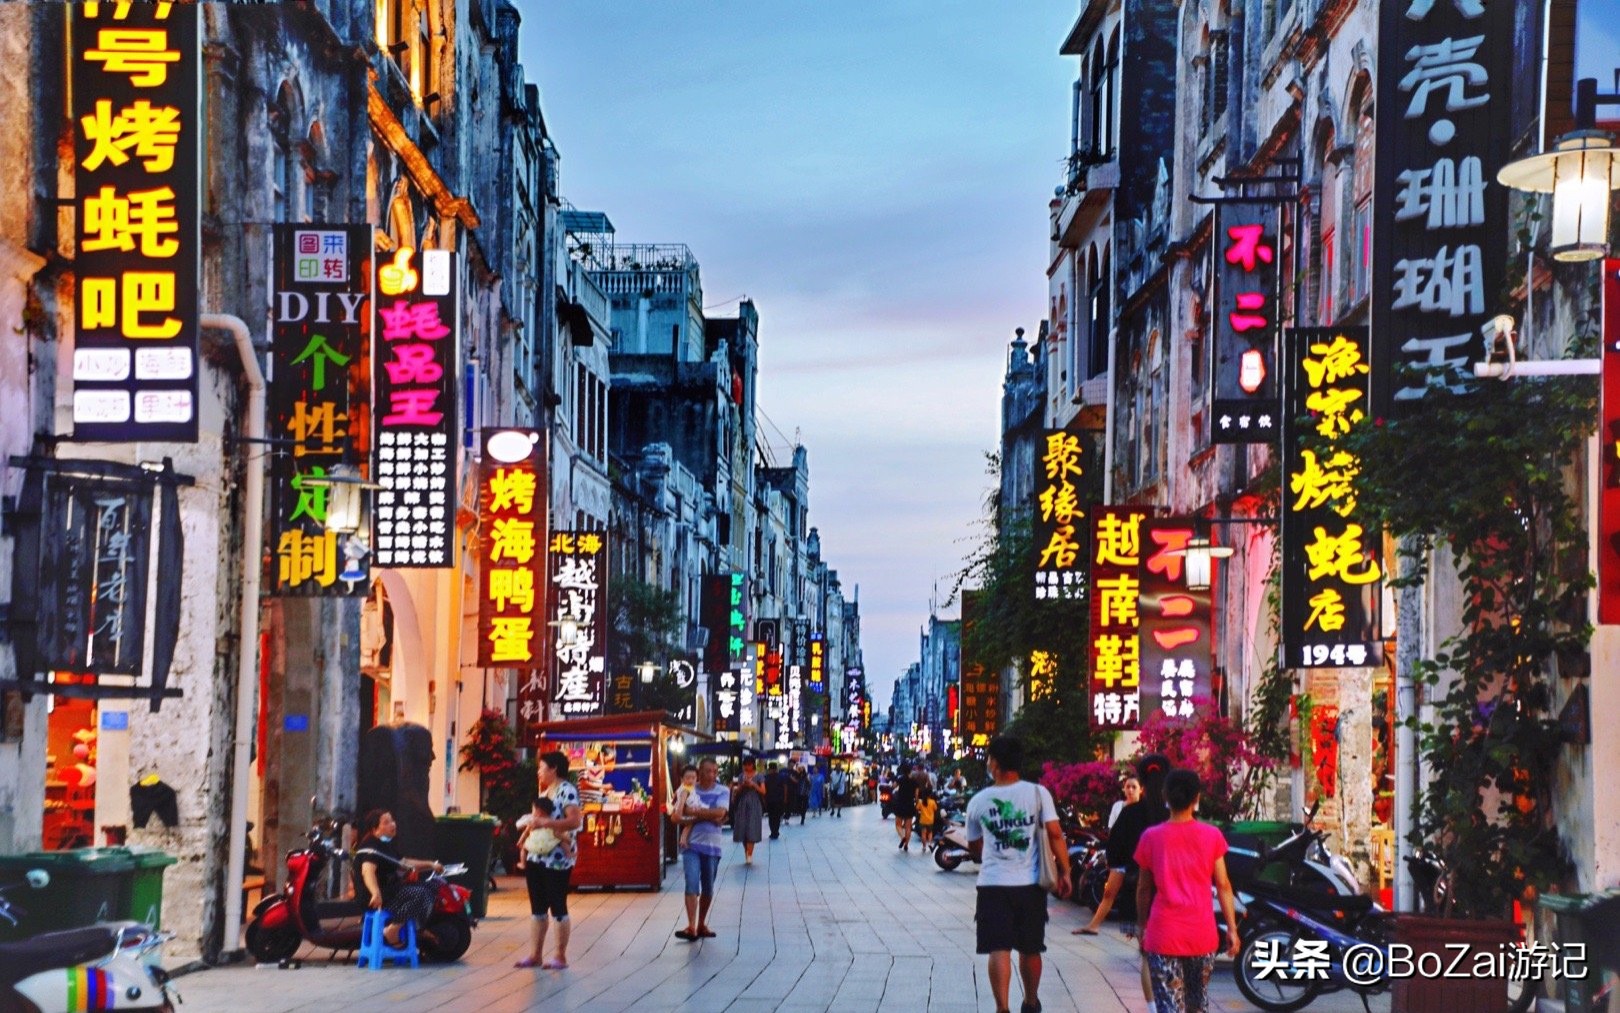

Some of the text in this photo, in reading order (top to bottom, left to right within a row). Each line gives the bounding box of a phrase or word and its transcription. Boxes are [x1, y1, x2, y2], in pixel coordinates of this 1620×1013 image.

[81, 0, 183, 339] 号烤蚝吧
[277, 291, 366, 324] DIY
[1225, 224, 1274, 333] 不二
[378, 300, 452, 427] 蚝品王
[276, 334, 351, 588] 个性定制
[488, 468, 536, 662] 烤海鸭蛋
[549, 534, 603, 555] 北海
[1093, 691, 1140, 725] 特产
